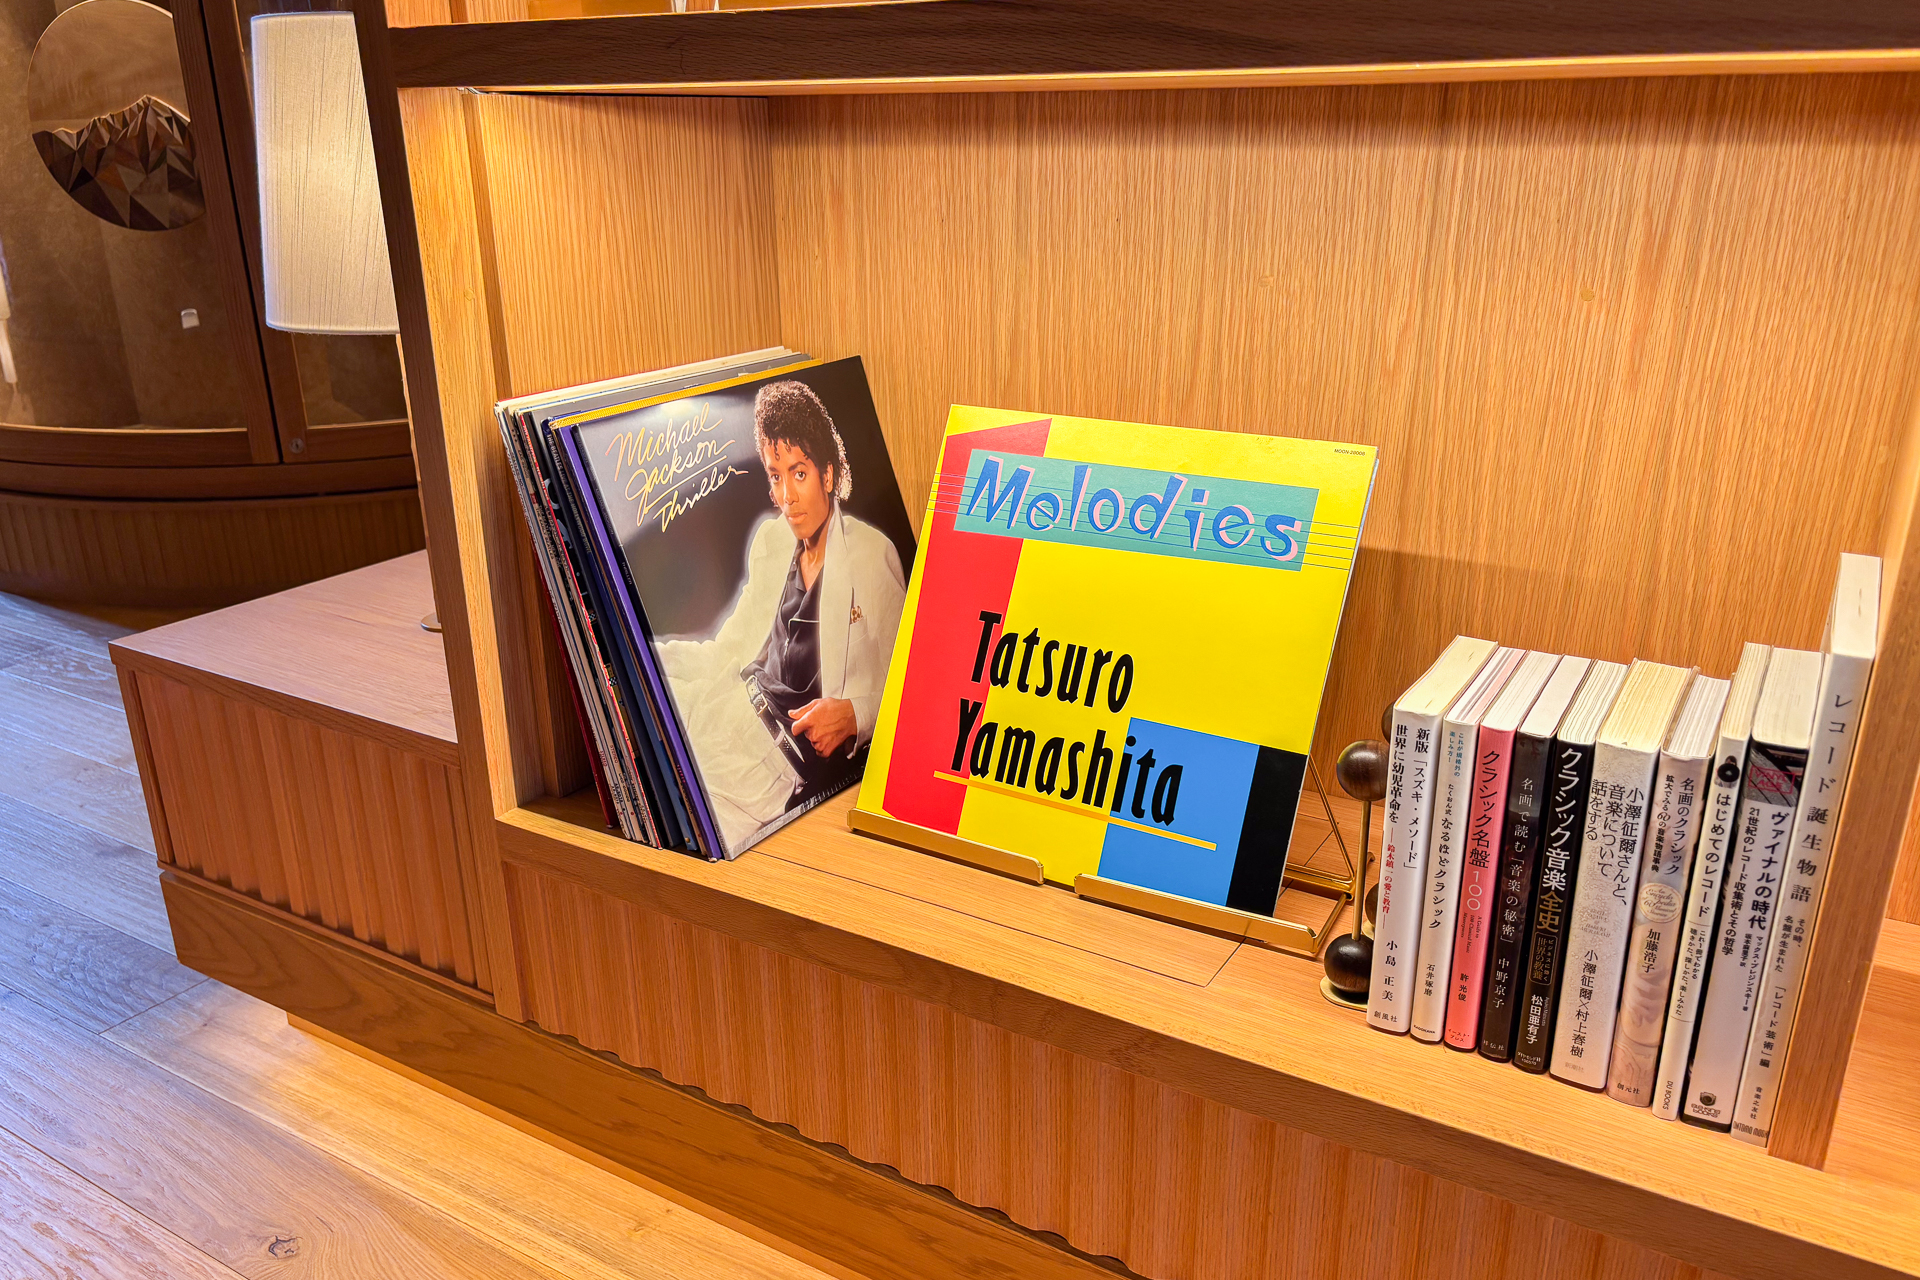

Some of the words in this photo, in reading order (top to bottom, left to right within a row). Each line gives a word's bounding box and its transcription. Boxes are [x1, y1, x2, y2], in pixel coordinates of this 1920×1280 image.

[549, 445, 563, 470] BEATLES
[605, 402, 723, 482] Michael
[625, 439, 736, 527] Jackson
[653, 465, 749, 533] Thriller
[966, 455, 1302, 561] Melodies
[971, 610, 1134, 713] Tatsuro
[951, 698, 1184, 826] Yamashita
[1585, 779, 1607, 841] 話をする
[1598, 784, 1625, 877] 音楽について
[1664, 777, 1694, 875] 名画のクラシック
[1791, 694, 1852, 902] レコード誕生物語
[1699, 793, 1731, 917] はじめてのレコード
[1722, 807, 1760, 956] 21世紀のレコード収集術とその哲学
[1749, 812, 1790, 931] ヴァイナルの時代
[1641, 928, 1661, 973] 加藤浩子
[1775, 915, 1793, 972] 名盤が生まれた
[1373, 1010, 1398, 1023] 創風社
[1458, 973, 1469, 1002] 許光俊
[1494, 958, 1510, 1008] 中野京子
[1526, 994, 1543, 1044] 松田亜有子
[1662, 1089, 1672, 1110] BOOKS
[1666, 1080, 1673, 1089] DU
[1750, 1086, 1763, 1120] 音楽之友社
